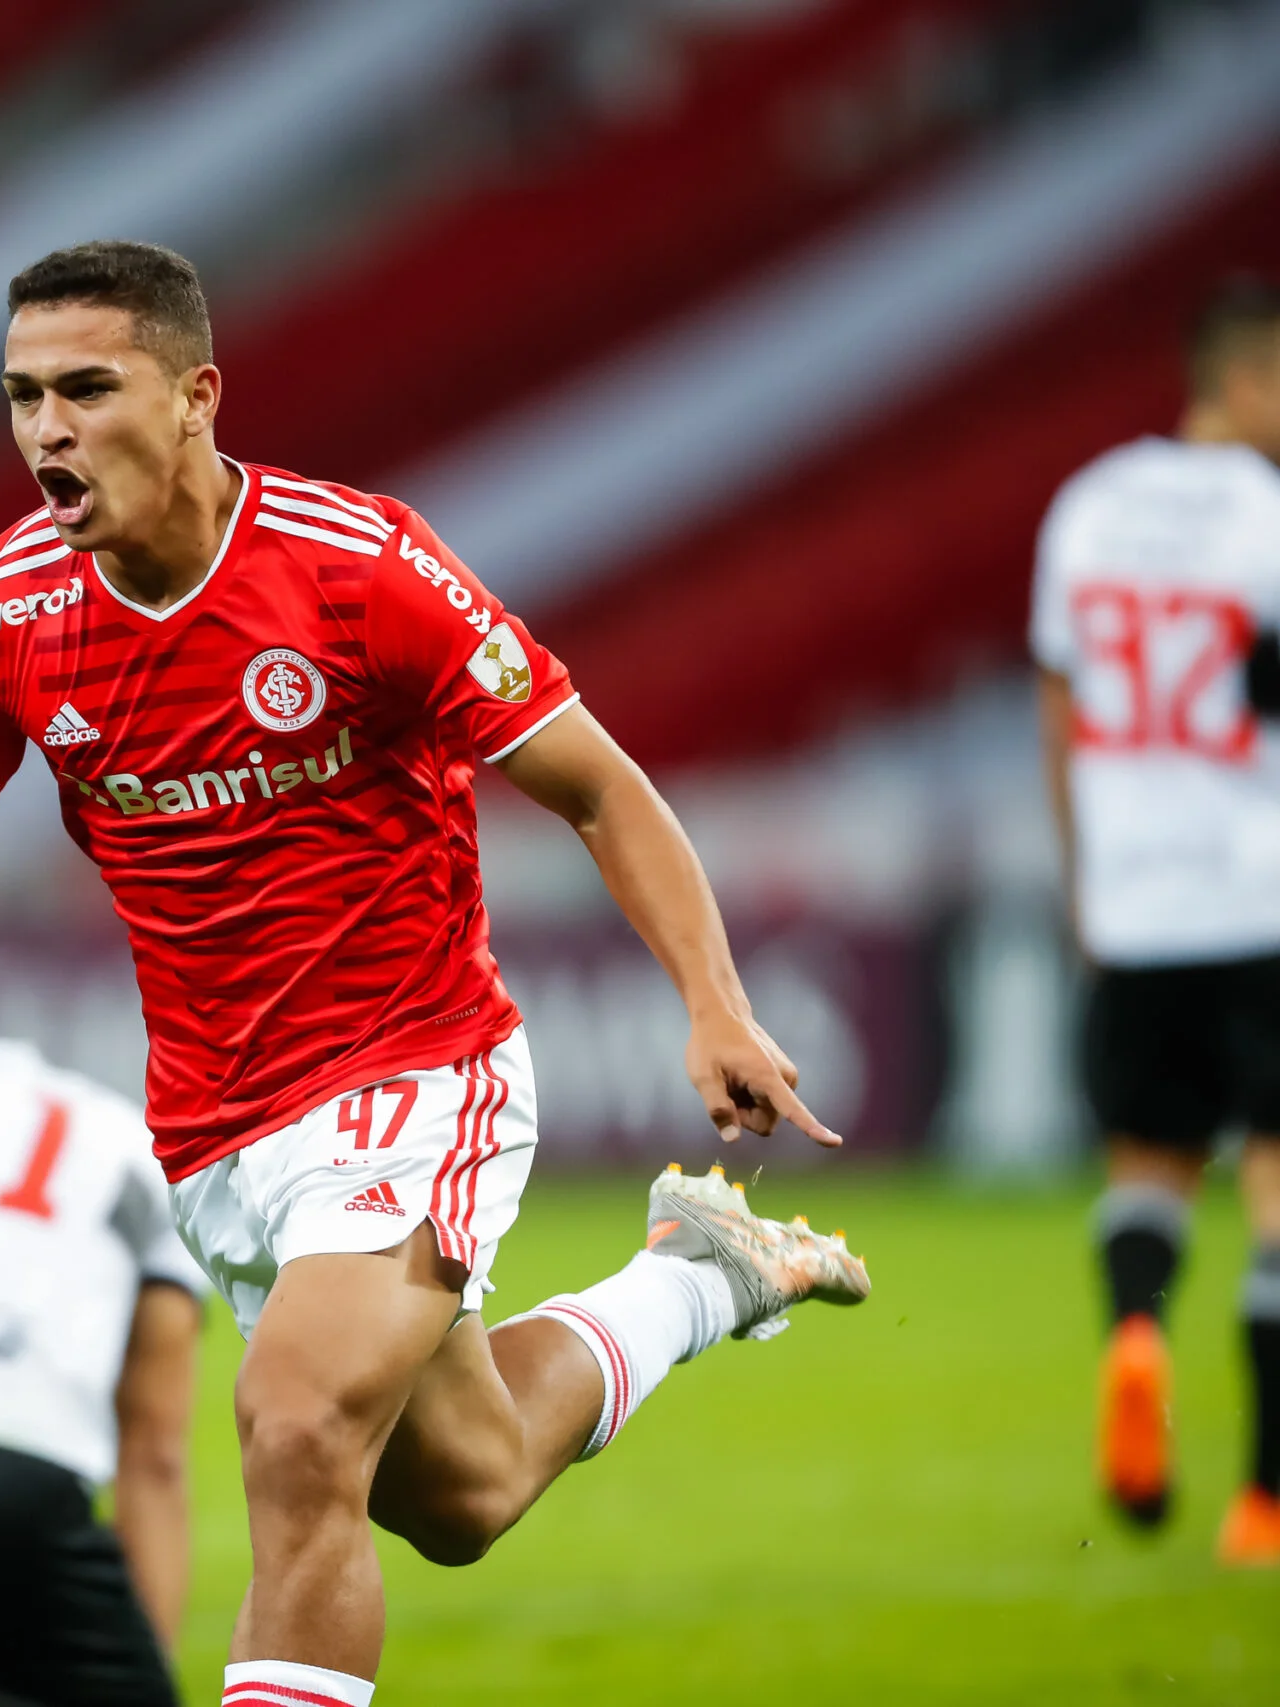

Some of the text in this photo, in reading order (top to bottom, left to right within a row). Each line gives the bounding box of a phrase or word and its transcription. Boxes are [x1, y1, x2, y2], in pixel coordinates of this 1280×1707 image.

[399, 533, 473, 610] vero
[504, 671, 518, 687] 2
[44, 727, 101, 747] adidas
[103, 727, 353, 815] Banrisul
[337, 1080, 418, 1150] 47
[344, 1200, 407, 1218] adidas
